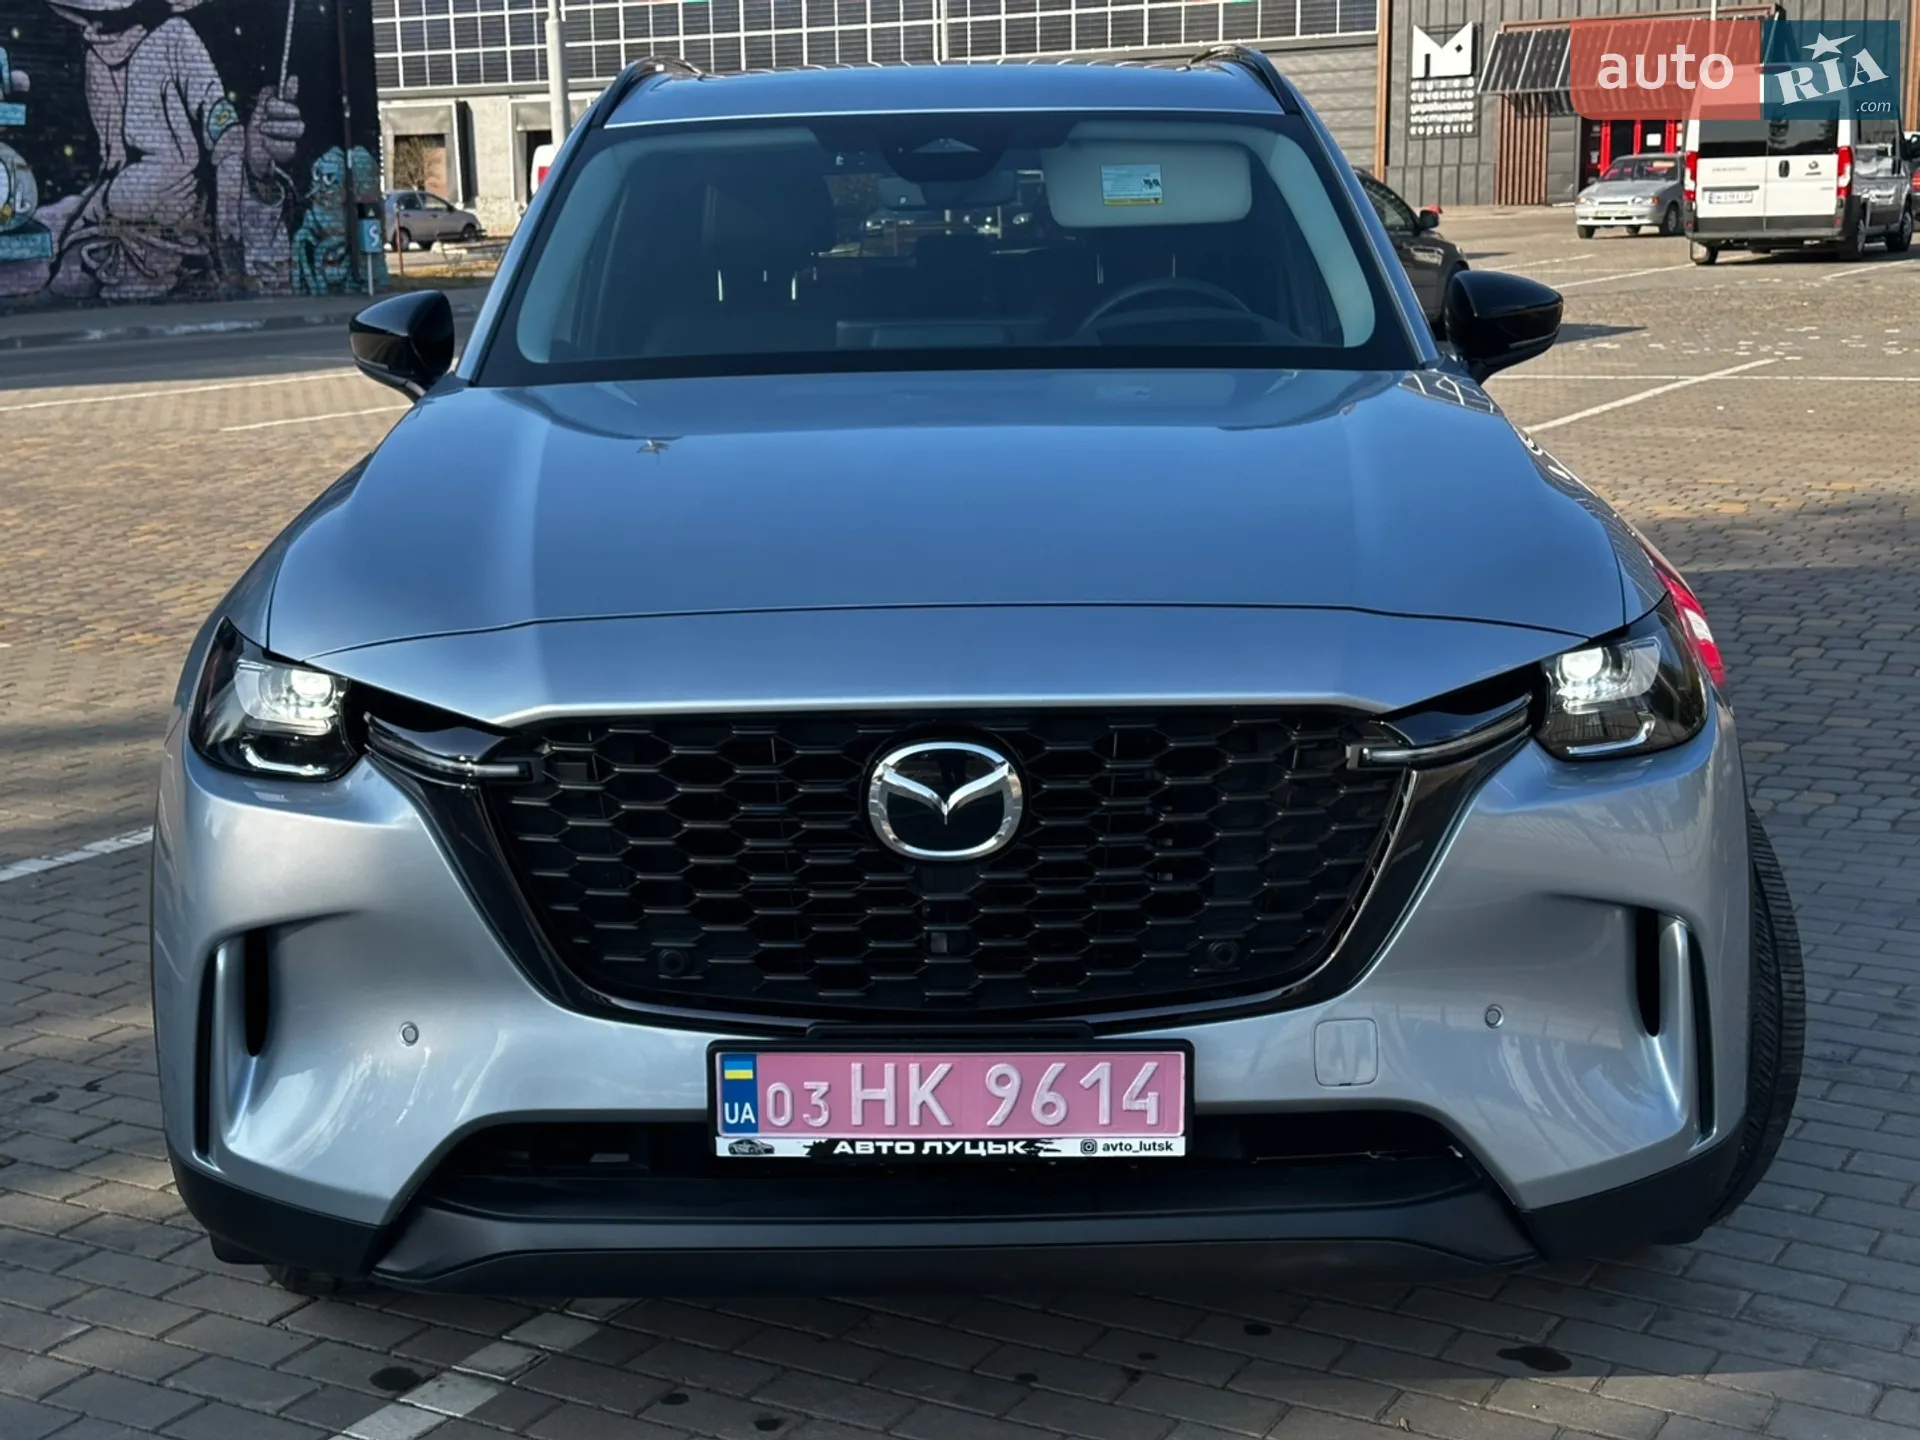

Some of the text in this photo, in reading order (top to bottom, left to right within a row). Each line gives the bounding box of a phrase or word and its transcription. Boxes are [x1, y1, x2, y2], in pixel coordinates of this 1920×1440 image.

[766, 1061, 1160, 1127] 03 HK 9614
[724, 1102, 756, 1124] UA
[832, 1140, 1027, 1156] АВТО ЛУЦЬК
[1102, 1140, 1174, 1154] avto_lutsk
